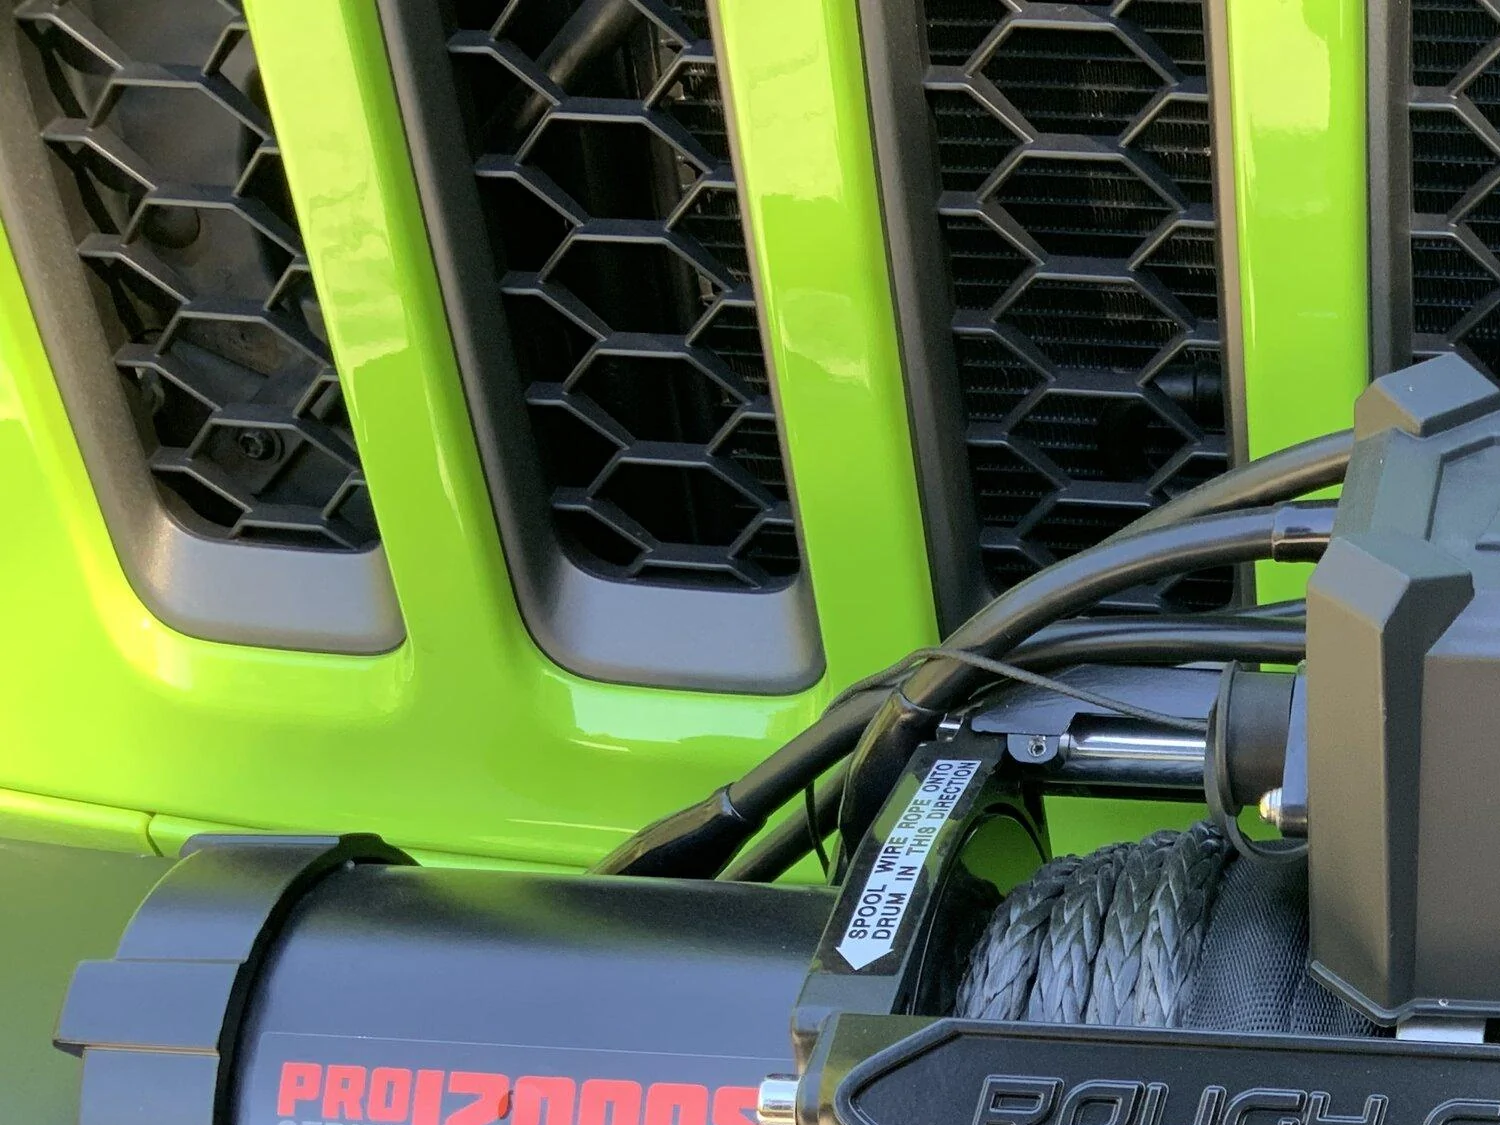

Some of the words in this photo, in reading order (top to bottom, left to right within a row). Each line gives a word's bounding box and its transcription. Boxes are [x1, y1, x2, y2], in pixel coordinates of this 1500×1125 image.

[849, 884, 886, 939] SPOOL
[875, 836, 908, 873] WIRE
[897, 799, 931, 829] ROPE
[922, 763, 953, 792] ONTO
[871, 893, 906, 940] DRUM
[895, 866, 917, 882] IN
[906, 826, 936, 856] THIS
[927, 761, 977, 819] DIRECTION
[277, 1061, 412, 1122] PRO
